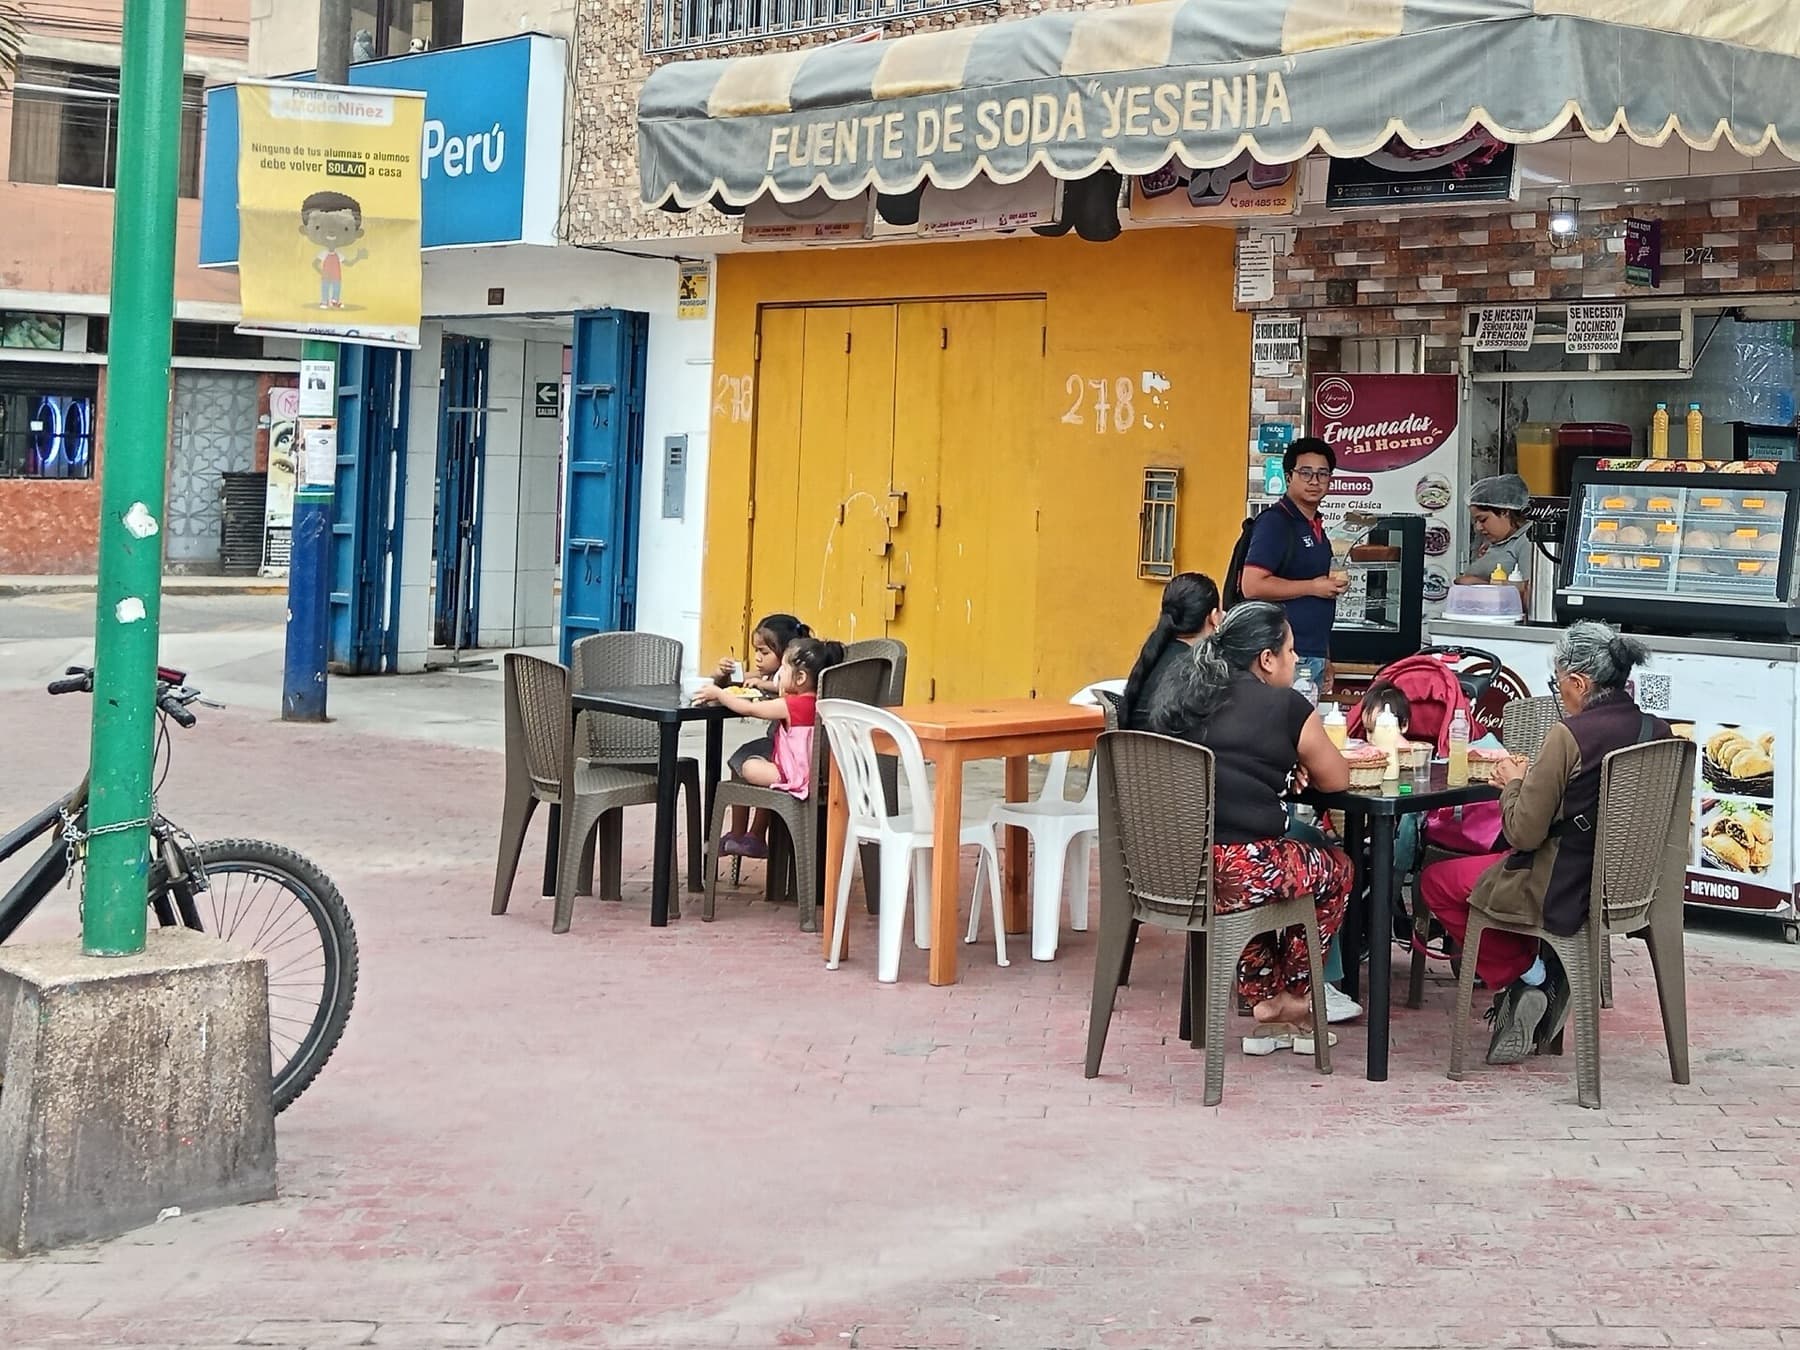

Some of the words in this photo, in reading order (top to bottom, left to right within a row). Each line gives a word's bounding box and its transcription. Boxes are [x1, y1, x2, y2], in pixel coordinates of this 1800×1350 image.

[767, 112, 904, 171] FUENTE
[916, 105, 964, 157] DE
[976, 89, 1085, 151] SODA
[252, 143, 290, 155] Ninguno
[293, 145, 304, 155] de
[307, 146, 321, 157] tus
[324, 148, 362, 159] alumnas
[373, 152, 410, 162] alumnos
[422, 120, 504, 179] Perú
[260, 158, 286, 170] debe
[290, 159, 324, 172] volver
[327, 161, 365, 176] SOLA/O
[368, 167, 374, 175] a
[378, 167, 402, 178] casa
[1239, 200, 1253, 208] 981
[1254, 199, 1271, 207] 485
[1273, 198, 1286, 206] 132
[1685, 247, 1715, 264] 274
[1482, 309, 1493, 321] SE
[1494, 308, 1534, 321] NECESITA
[1570, 307, 1581, 318] SE
[1583, 306, 1624, 319] NECESITA
[1512, 322, 1528, 331] PARA
[1574, 320, 1617, 333] COCINERO
[1568, 333, 1583, 342] CON
[1577, 342, 1618, 351] 955705000
[714, 373, 753, 422] 278
[1061, 374, 1135, 434] 278
[1323, 413, 1432, 444] Empanadas
[1354, 441, 1371, 454] al
[1375, 435, 1434, 452] Horno
[1328, 479, 1371, 491] ellenos:
[1319, 501, 1346, 509] Carne
[1348, 500, 1382, 509] Clásica
[1691, 880, 1740, 900] REYNOSO
